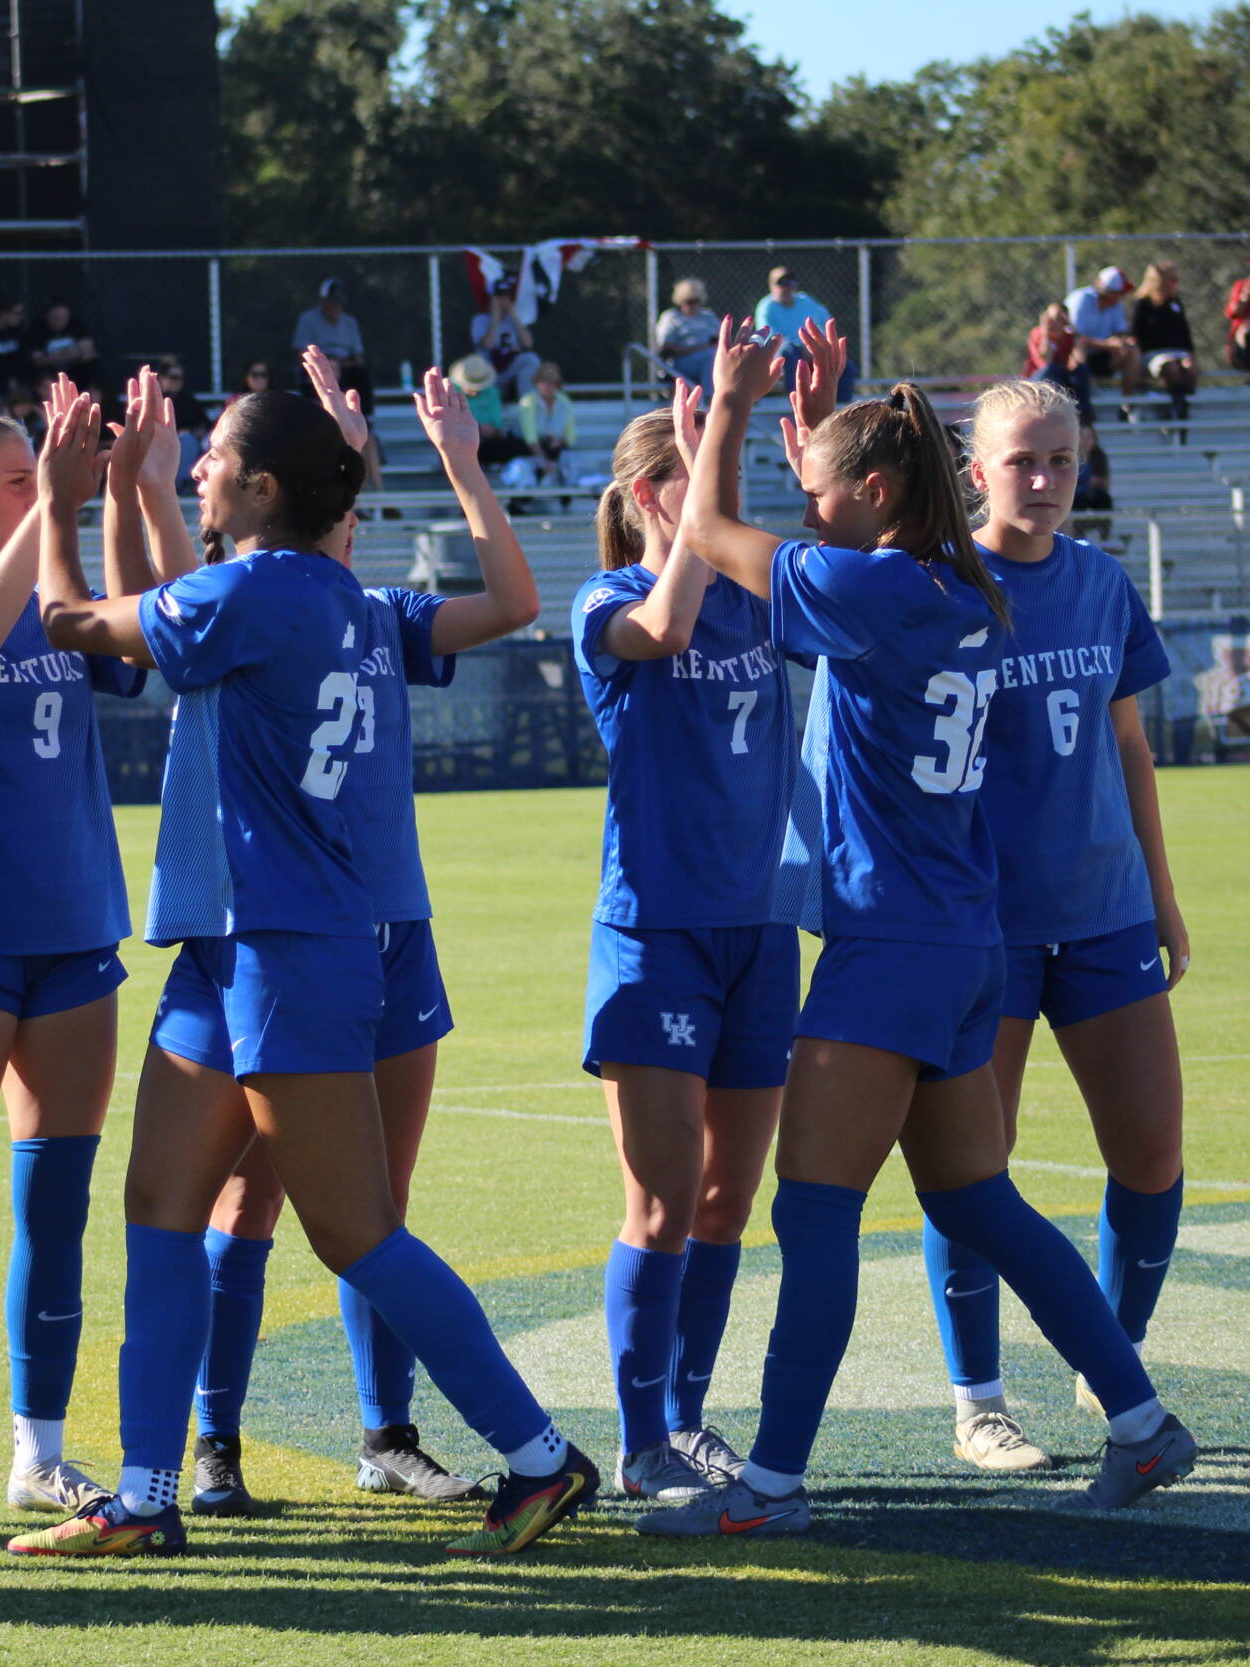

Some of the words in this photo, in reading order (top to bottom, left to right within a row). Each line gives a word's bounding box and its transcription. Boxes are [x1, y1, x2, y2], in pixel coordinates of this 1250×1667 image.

[1000, 645, 1114, 689] ENTUCKY
[33, 691, 63, 759] 9
[727, 690, 758, 755] 7
[1046, 688, 1080, 757] 6
[660, 1012, 696, 1046] UK
